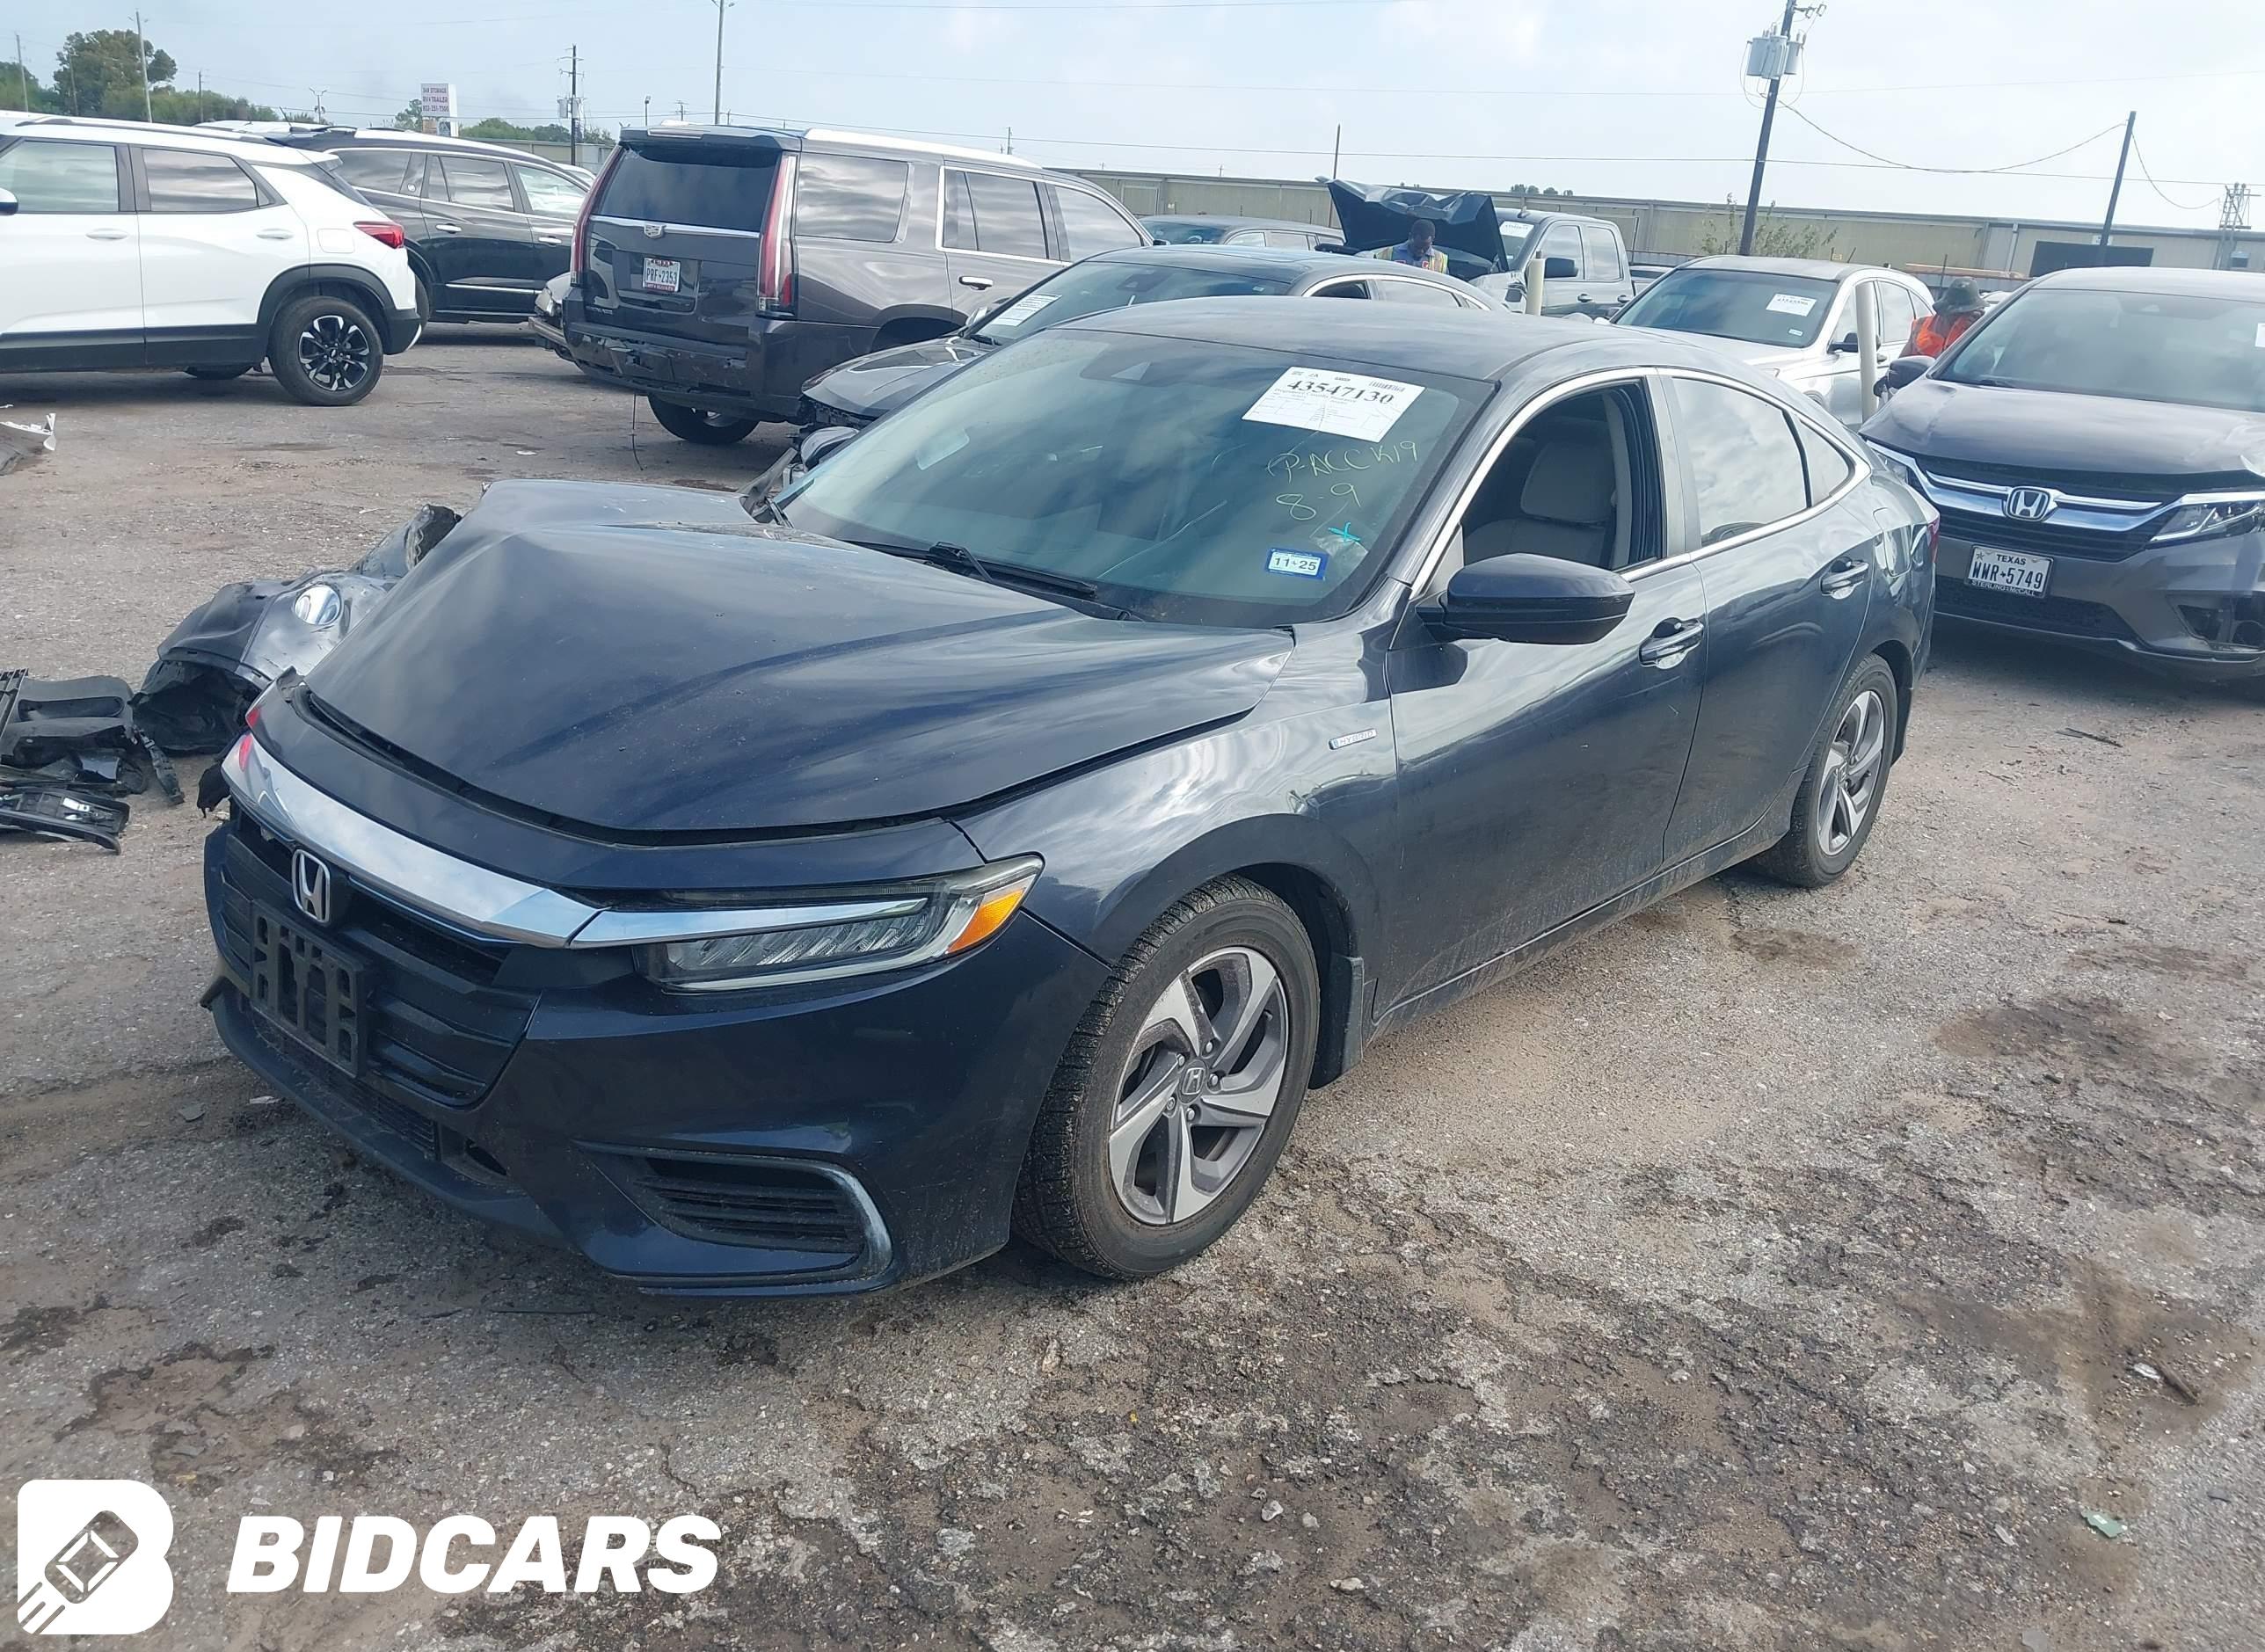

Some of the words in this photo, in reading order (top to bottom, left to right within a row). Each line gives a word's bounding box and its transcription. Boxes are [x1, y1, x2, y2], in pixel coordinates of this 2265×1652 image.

[1287, 380, 1395, 404] 43547130
[1996, 553, 2027, 566] TEXAS
[1340, 731, 1373, 745] HYBRID
